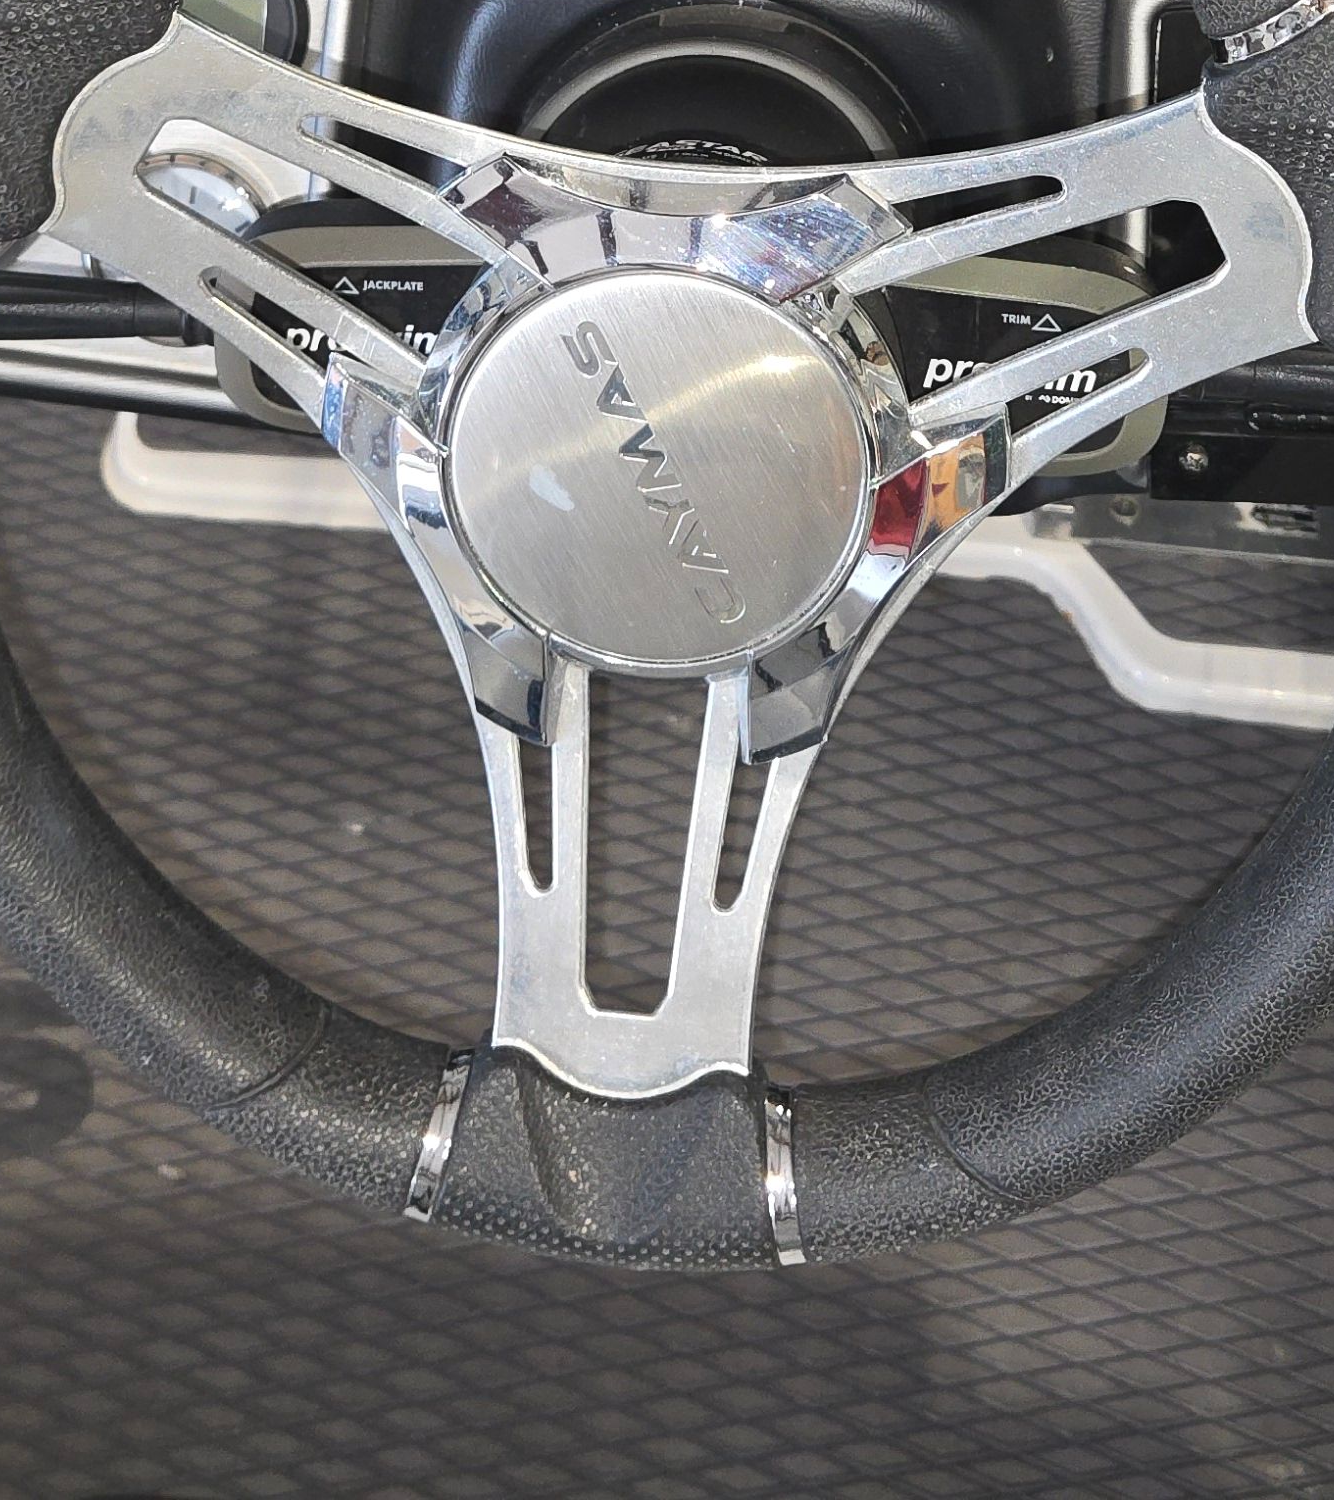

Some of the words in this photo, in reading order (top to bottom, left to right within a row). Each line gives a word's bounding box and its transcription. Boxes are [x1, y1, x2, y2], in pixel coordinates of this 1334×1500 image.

[363, 279, 424, 291] JACKPLATE
[1001, 313, 1032, 325] TRIM
[560, 320, 746, 624] CAYMAS
